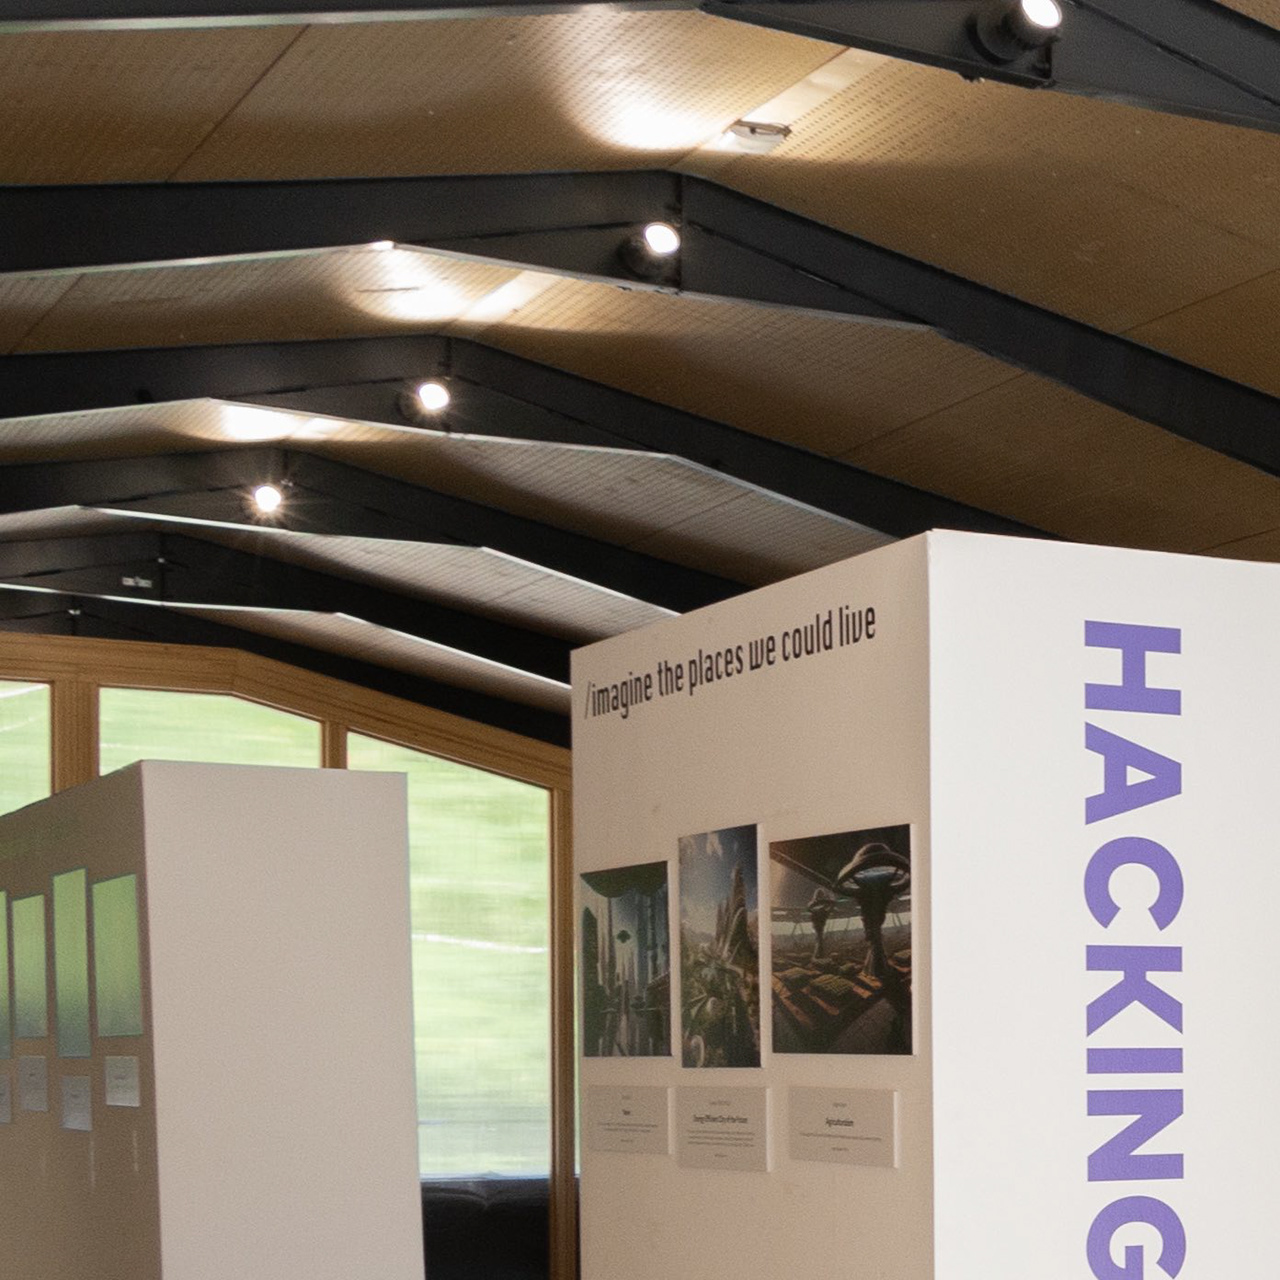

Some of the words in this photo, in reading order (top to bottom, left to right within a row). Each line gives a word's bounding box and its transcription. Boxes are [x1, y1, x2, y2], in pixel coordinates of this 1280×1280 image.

[585, 681, 652, 719] /imagine
[657, 661, 684, 697] the
[688, 645, 743, 696] places
[749, 635, 775, 671] we
[782, 609, 833, 661] could
[839, 605, 876, 647] live
